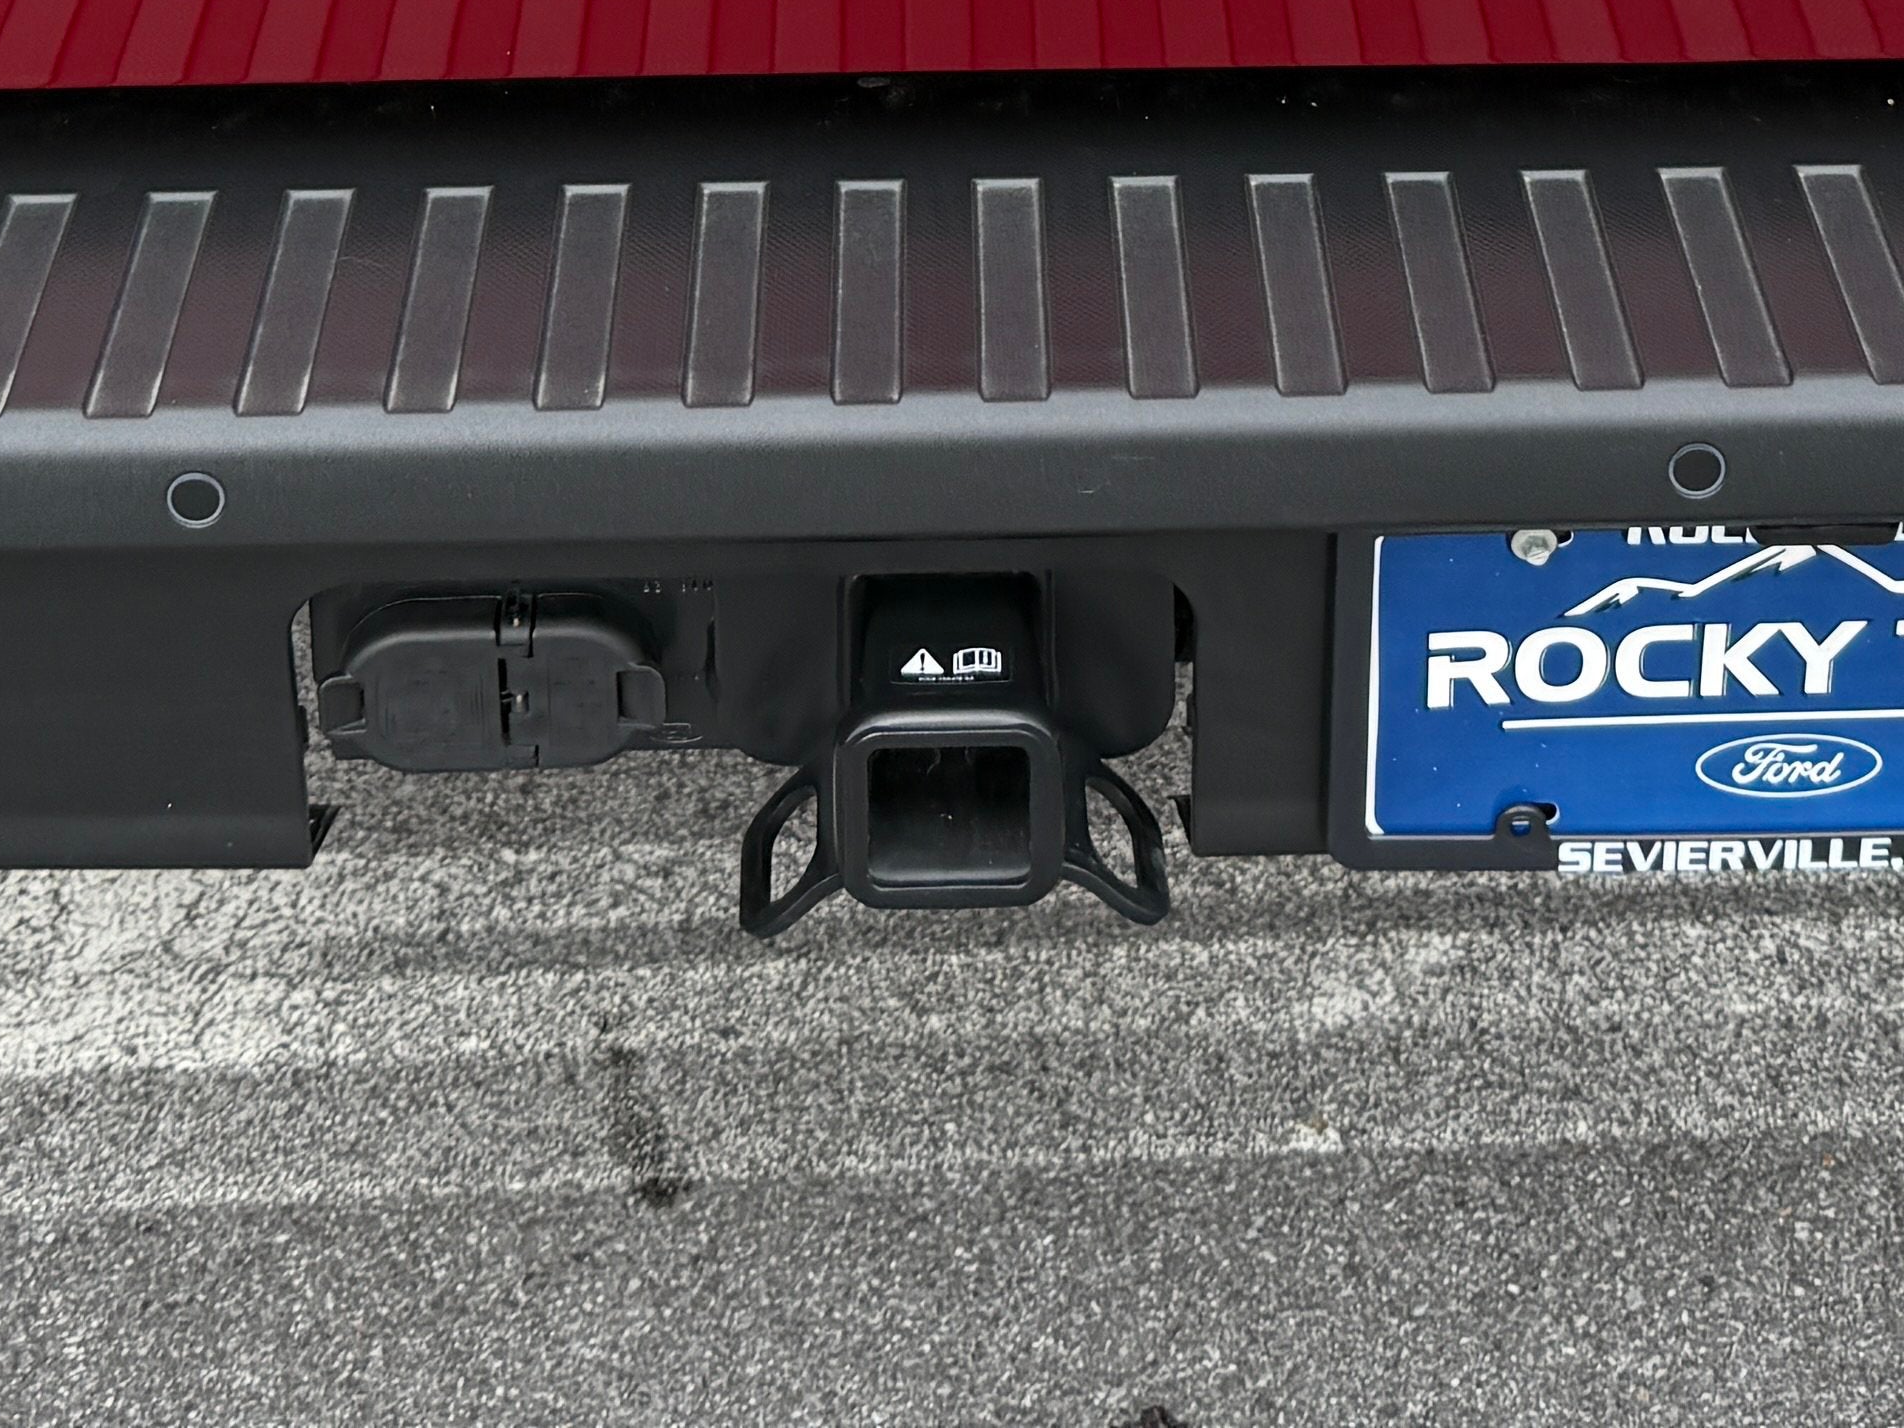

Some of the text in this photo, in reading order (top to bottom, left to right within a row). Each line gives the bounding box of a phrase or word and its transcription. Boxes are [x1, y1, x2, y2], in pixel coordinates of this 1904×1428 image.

[1426, 620, 1867, 709] ROCKY
[1732, 743, 1843, 785] Ford
[1558, 837, 1904, 872] SEVIERVILLE,
